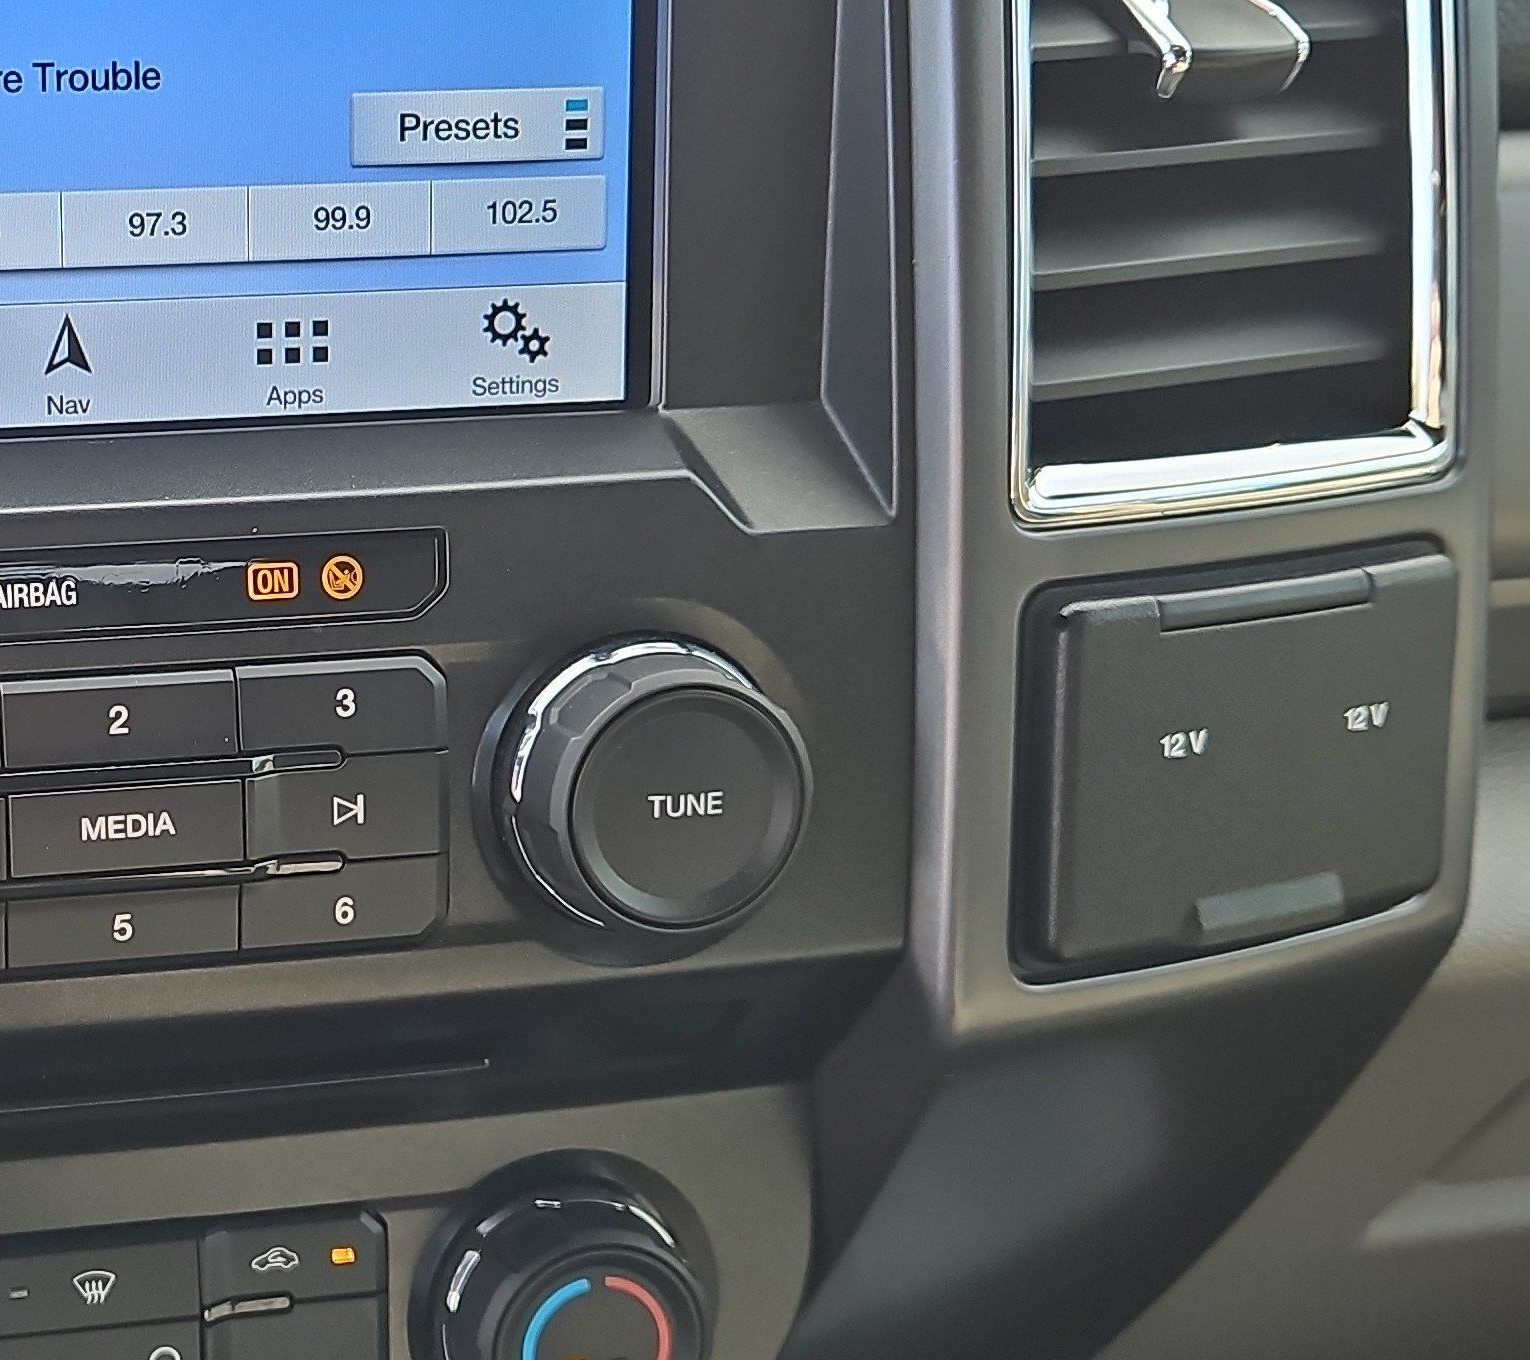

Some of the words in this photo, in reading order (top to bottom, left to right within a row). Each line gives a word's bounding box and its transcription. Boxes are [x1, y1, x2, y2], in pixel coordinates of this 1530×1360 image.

[33, 60, 162, 94] Trouble
[399, 111, 520, 140] Presets
[128, 212, 187, 238] 97.3
[313, 206, 371, 231] 99.9
[486, 199, 558, 225] 102.5
[266, 385, 324, 407] Apps
[472, 375, 559, 397] Settings
[47, 396, 91, 415] Nav
[256, 568, 290, 593] ON
[335, 688, 356, 718] 3
[108, 705, 129, 736] 2
[648, 791, 723, 818] TUNE
[81, 810, 175, 840] MEDIA
[334, 896, 354, 924] 6
[112, 913, 133, 942] 5
